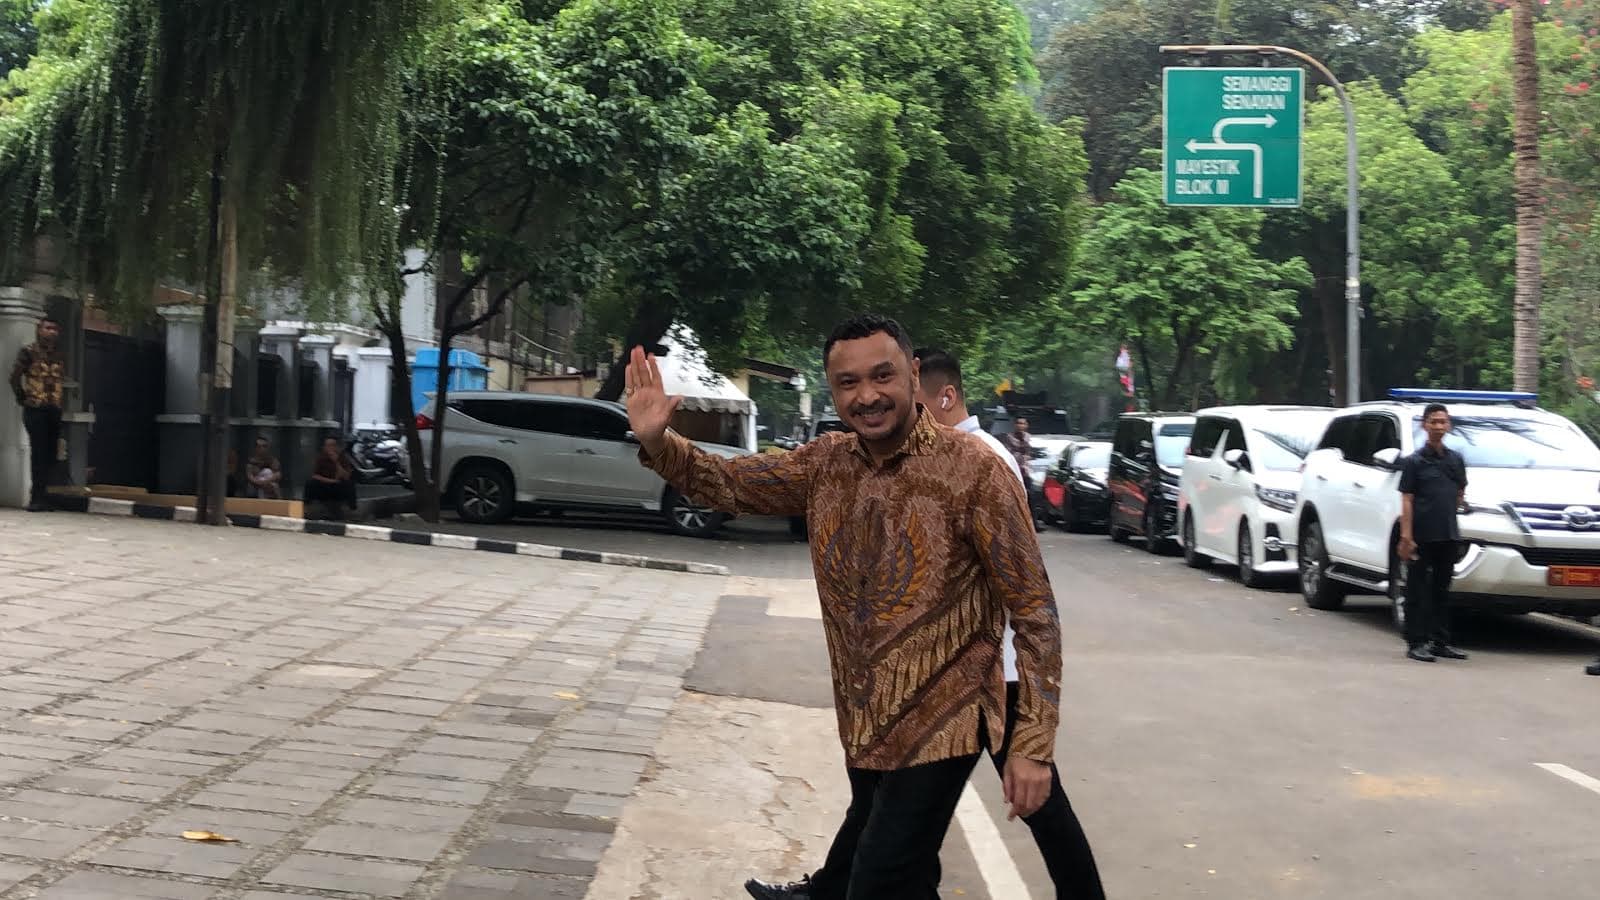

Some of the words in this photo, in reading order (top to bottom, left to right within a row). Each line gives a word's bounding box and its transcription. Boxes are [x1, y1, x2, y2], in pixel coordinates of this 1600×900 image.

[1222, 76, 1292, 92] SEMANGGI
[1221, 94, 1286, 110] SENAYAN
[1175, 159, 1240, 175] MAYESTIK
[1175, 179, 1214, 195] BLOK
[1215, 179, 1230, 195] M
